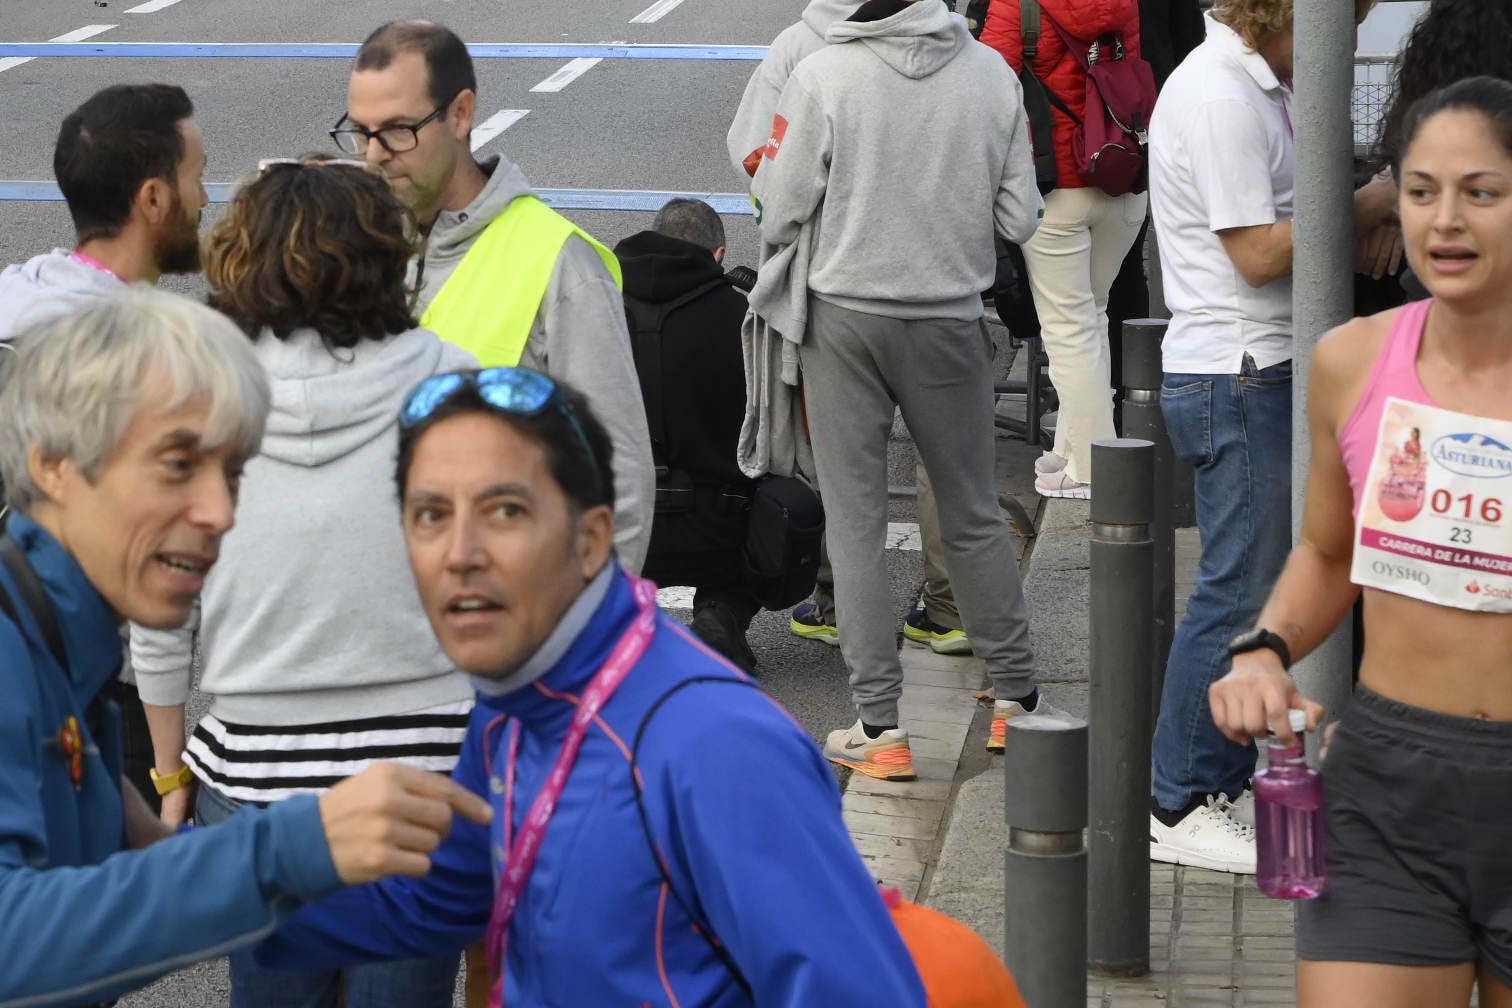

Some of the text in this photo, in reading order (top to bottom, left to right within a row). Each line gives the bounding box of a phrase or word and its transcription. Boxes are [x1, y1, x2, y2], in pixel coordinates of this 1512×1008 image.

[1431, 489, 1503, 523] 016
[1449, 527, 1472, 543] 23
[1379, 537, 1433, 558] CARRERA
[1434, 548, 1453, 561] DE
[1453, 552, 1470, 564] LA
[1372, 560, 1431, 586] OYSHO
